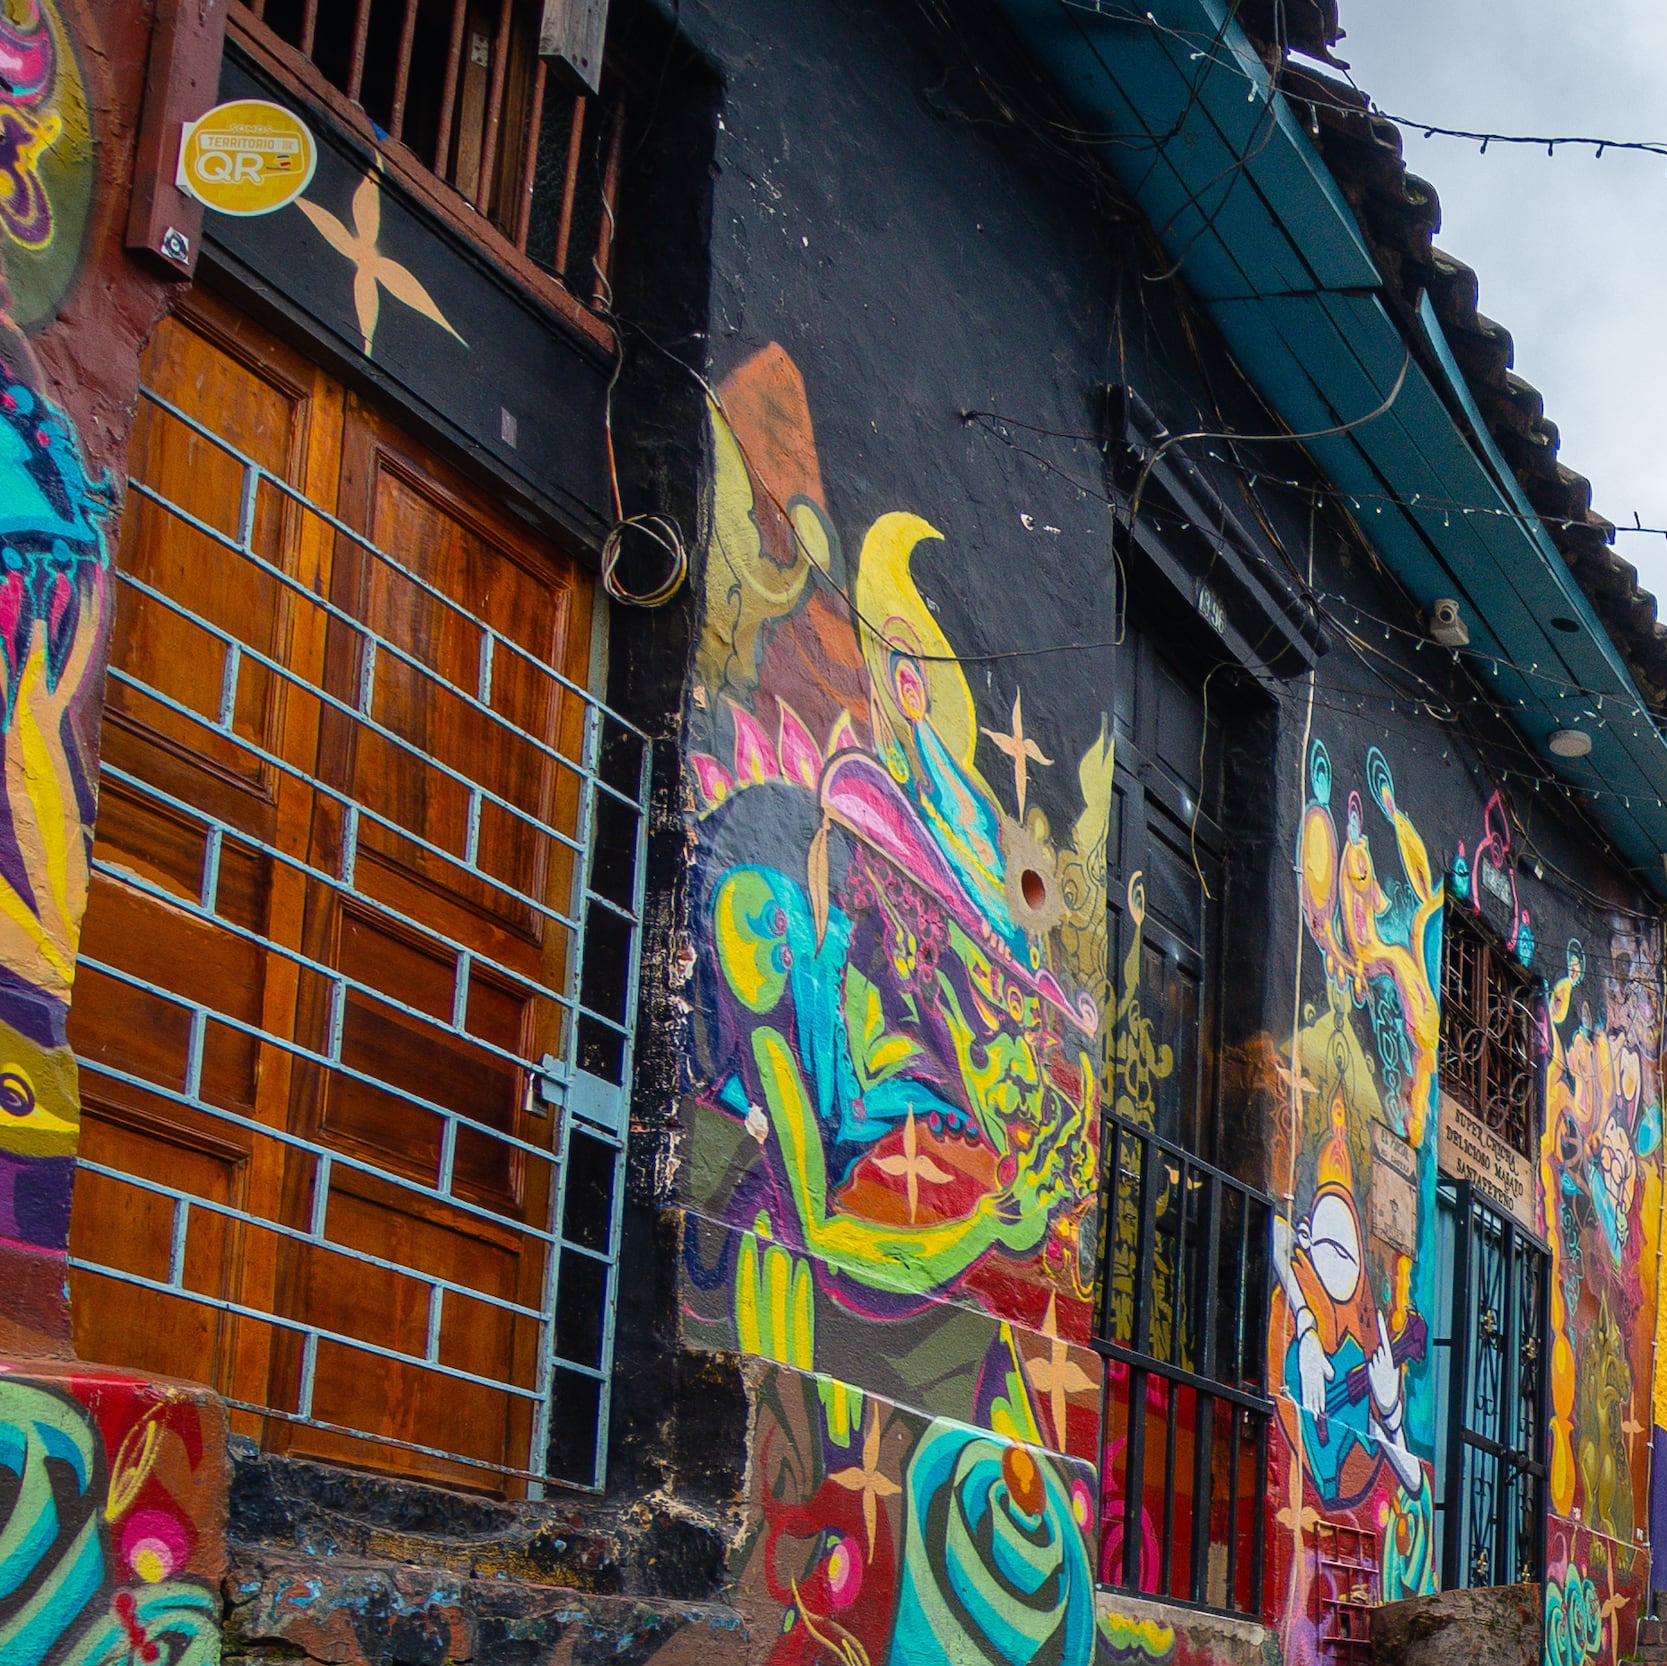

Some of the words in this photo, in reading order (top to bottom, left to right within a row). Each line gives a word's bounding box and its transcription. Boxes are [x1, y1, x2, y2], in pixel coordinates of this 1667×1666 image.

[207, 136, 275, 150] TERRITORIO
[229, 124, 273, 134] SOMOS
[197, 151, 263, 184] QR
[1455, 1108, 1486, 1148] SUPER
[1446, 1124, 1491, 1170] DELICIOSO
